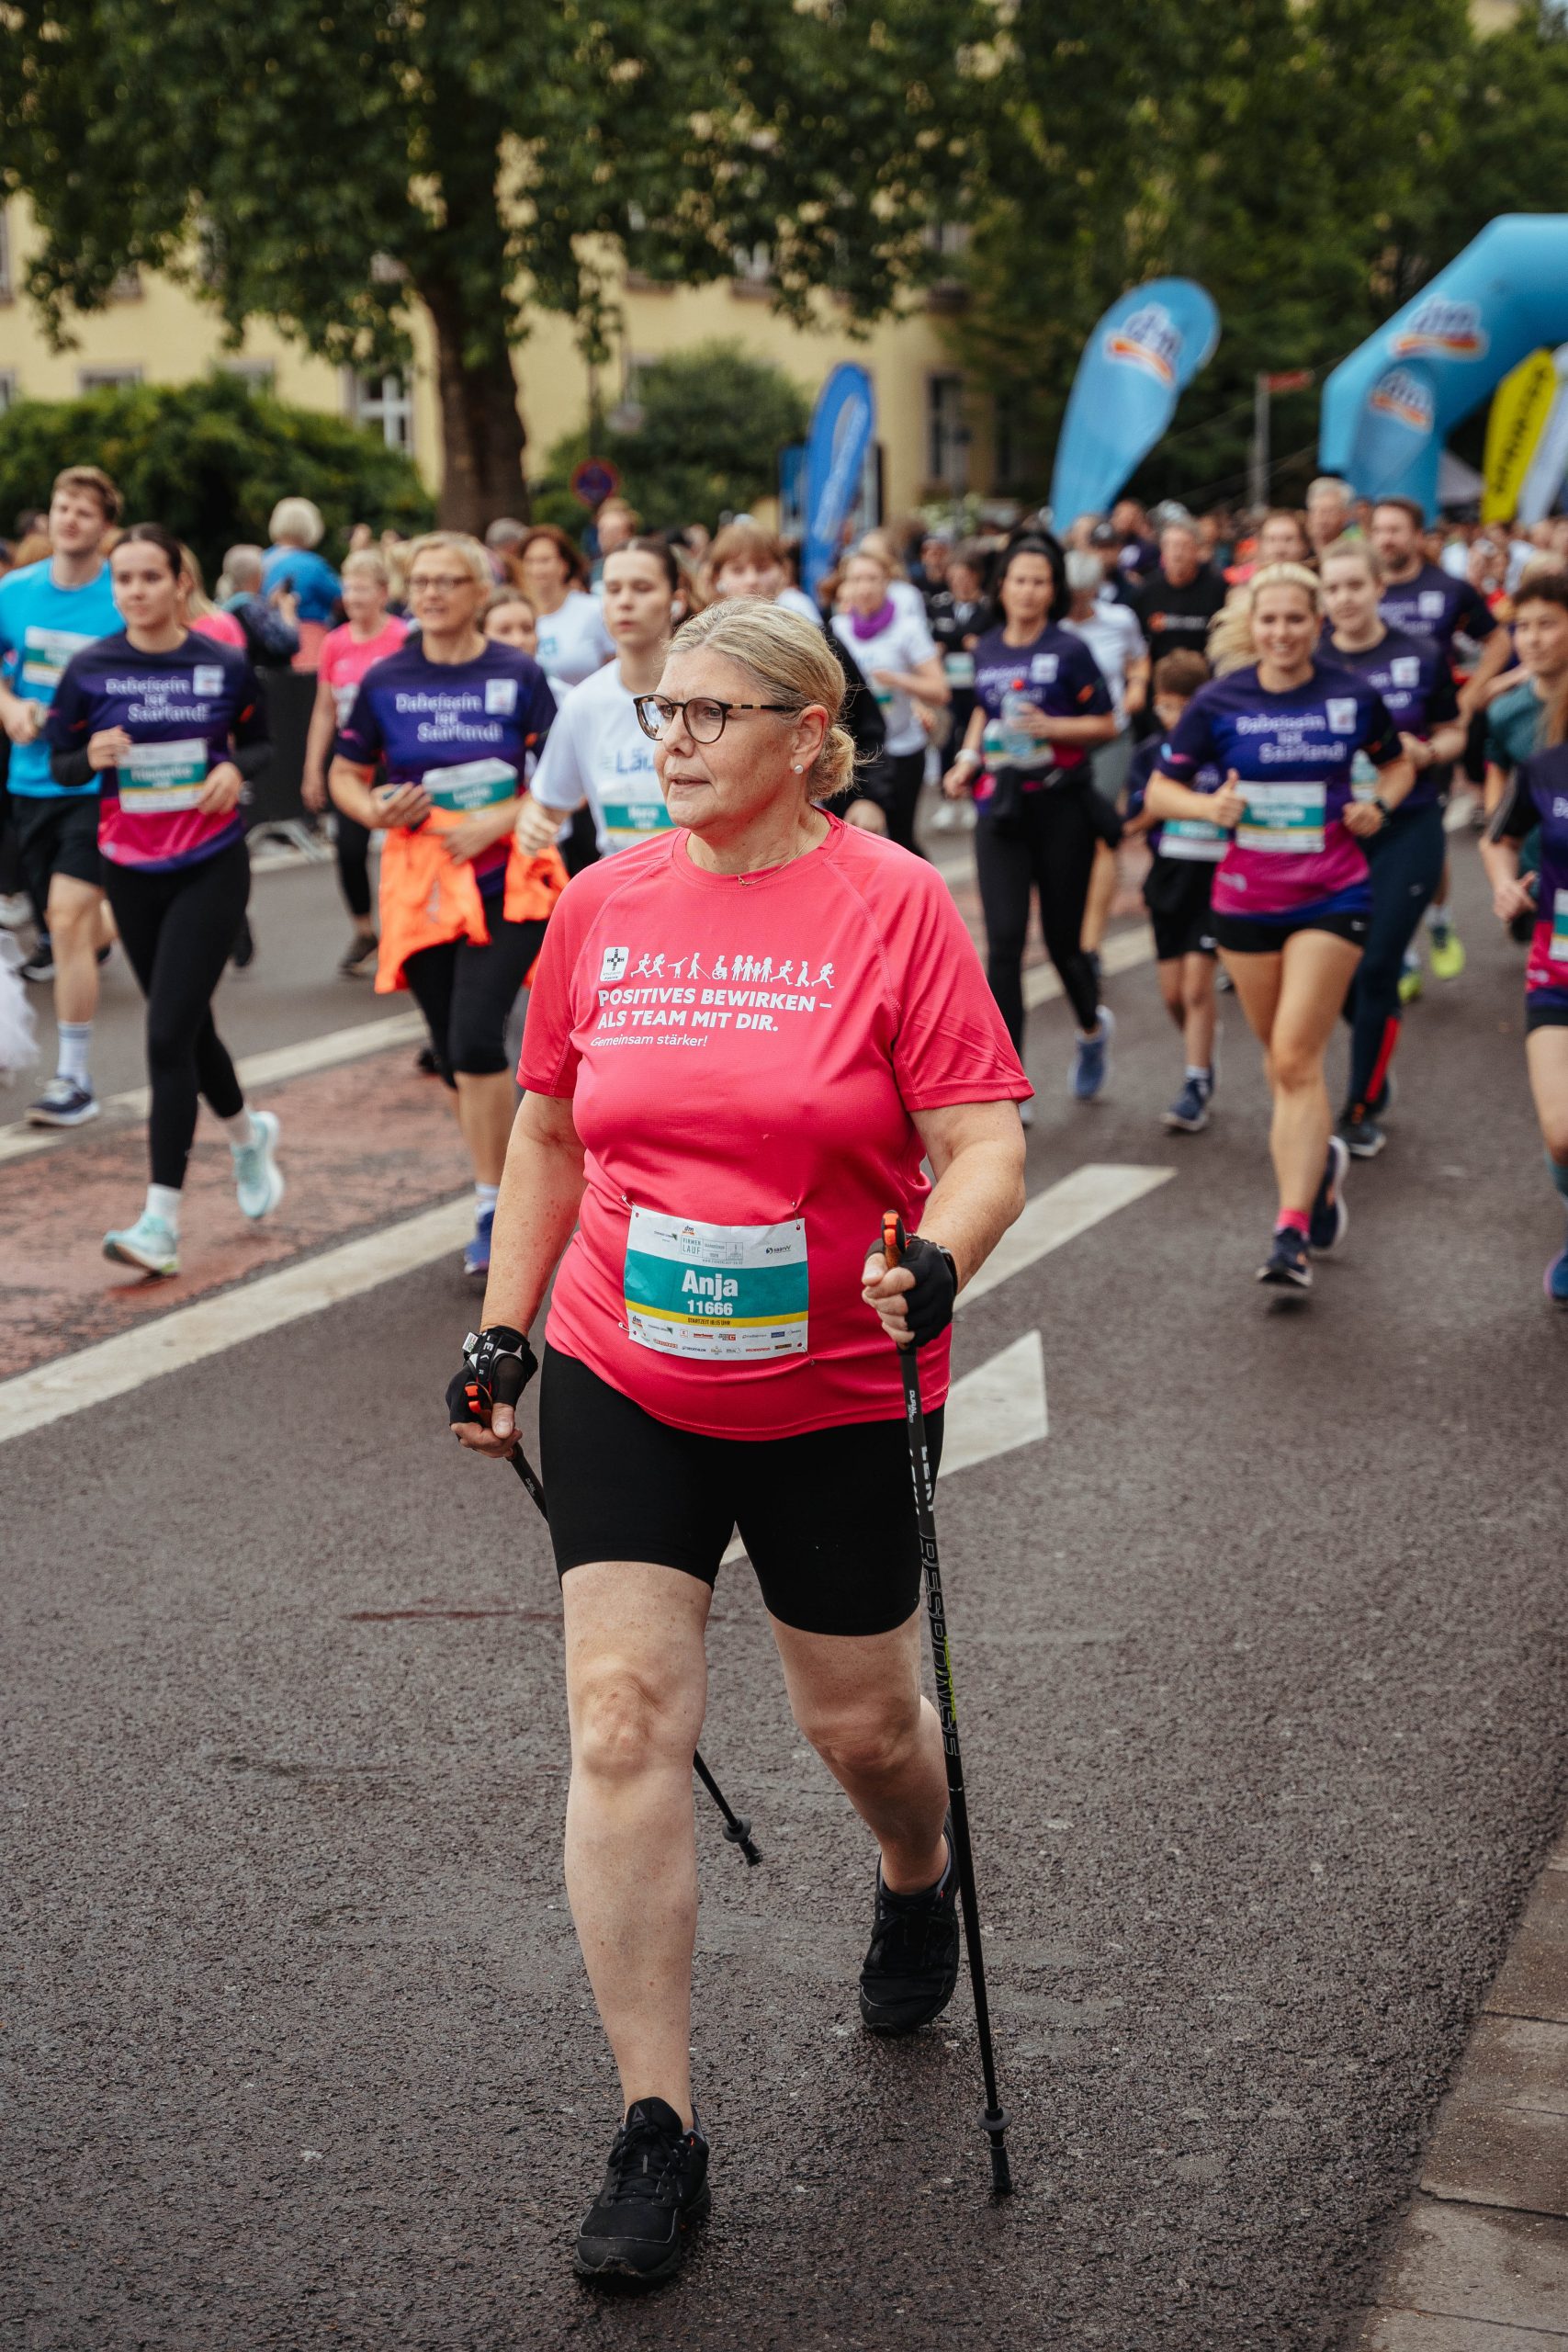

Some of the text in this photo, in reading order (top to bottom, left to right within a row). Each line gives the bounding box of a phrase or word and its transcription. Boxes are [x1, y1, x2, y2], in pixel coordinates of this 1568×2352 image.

[106, 676, 190, 695] Dabeisein
[396, 693, 482, 712] Dabeisein
[128, 703, 210, 722] Saarland!
[417, 722, 503, 742] Saarland!
[1236, 714, 1325, 735] Dabeisein
[598, 987, 696, 1008] POSITIVES
[701, 989, 817, 1012] BEWIRKEN
[597, 1010, 779, 1032] ALS TEAM MIT DIR.
[591, 1034, 708, 1047] Gemeinsam stärker!
[682, 1238, 701, 1246] FIRMEN
[682, 1245, 701, 1255] LAUF
[682, 1270, 739, 1301] Anja
[687, 1300, 733, 1316] 11666
[632, 1316, 642, 1324] dm
[909, 1390, 918, 1417] DURAL
